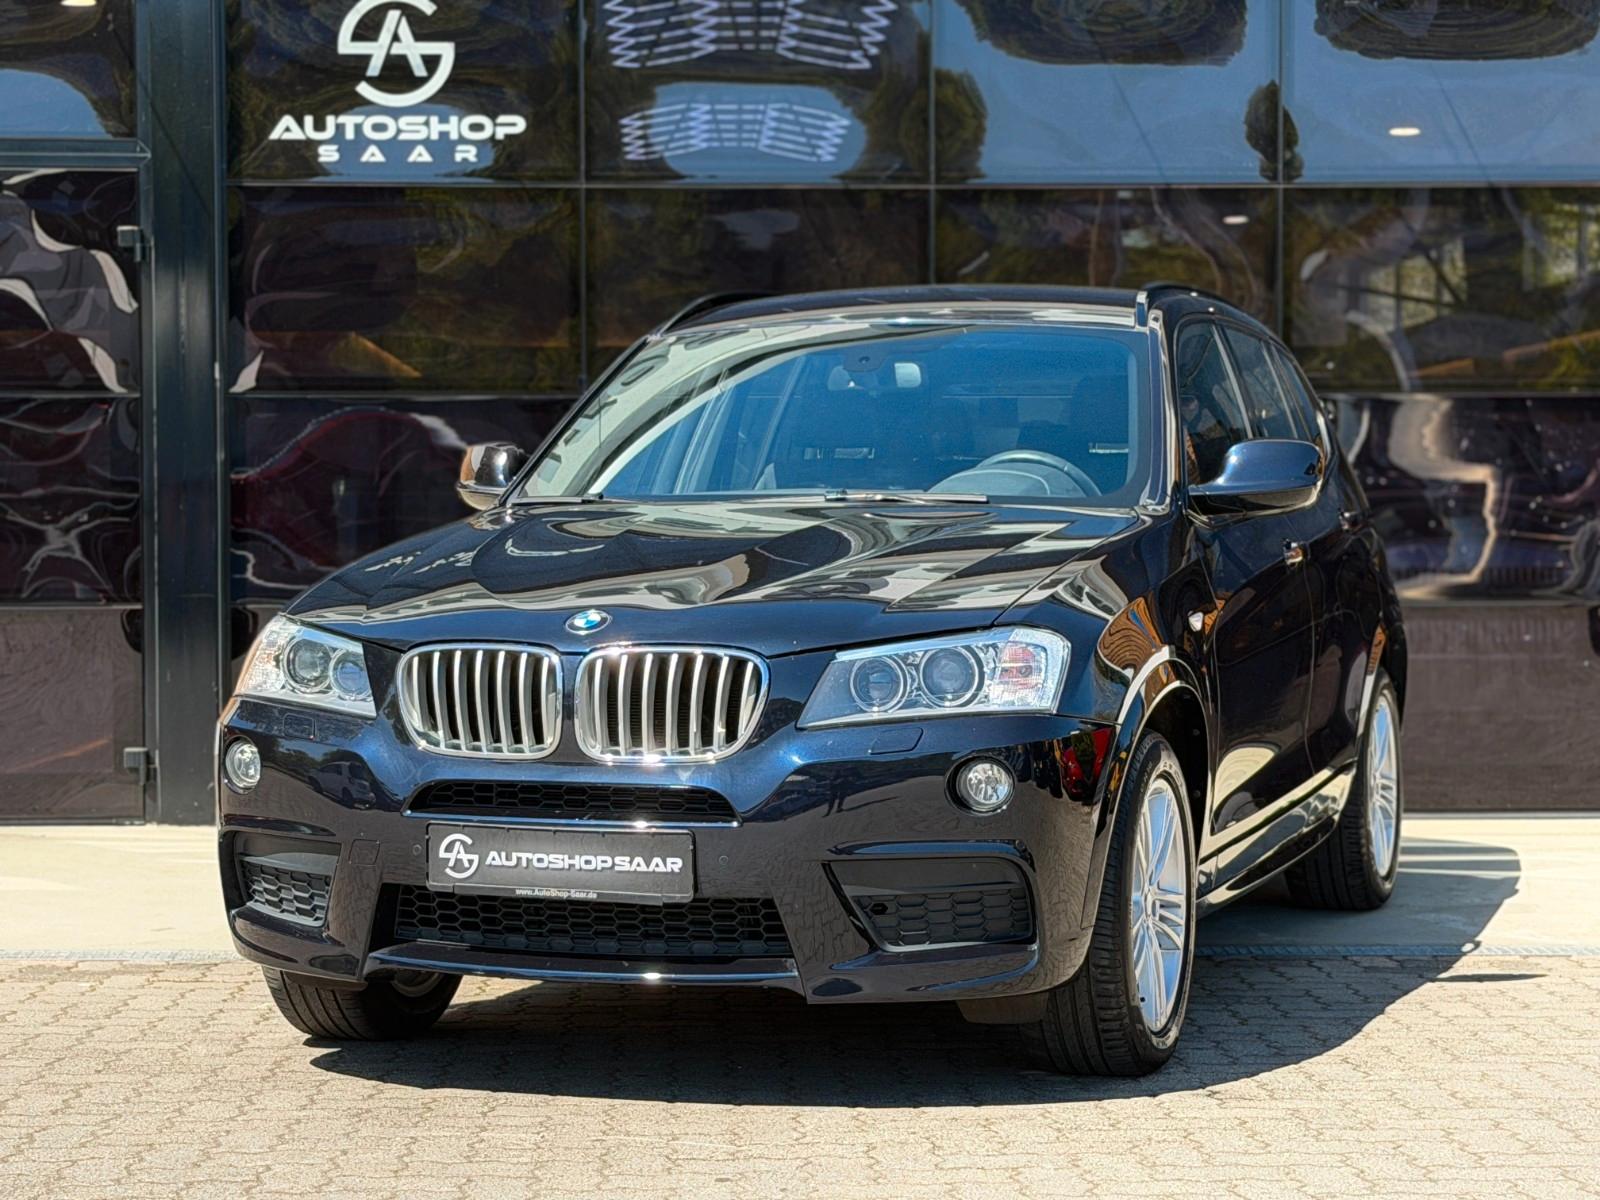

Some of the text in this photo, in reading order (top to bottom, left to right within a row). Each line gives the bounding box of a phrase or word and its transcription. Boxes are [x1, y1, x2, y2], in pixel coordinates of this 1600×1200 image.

[268, 114, 527, 140] AUTOSHOP
[317, 144, 478, 163] SAAR
[485, 850, 612, 870] AUTOSHOP
[614, 856, 683, 873] SAAR
[515, 888, 598, 899] www.AutoShop-Saar.de
